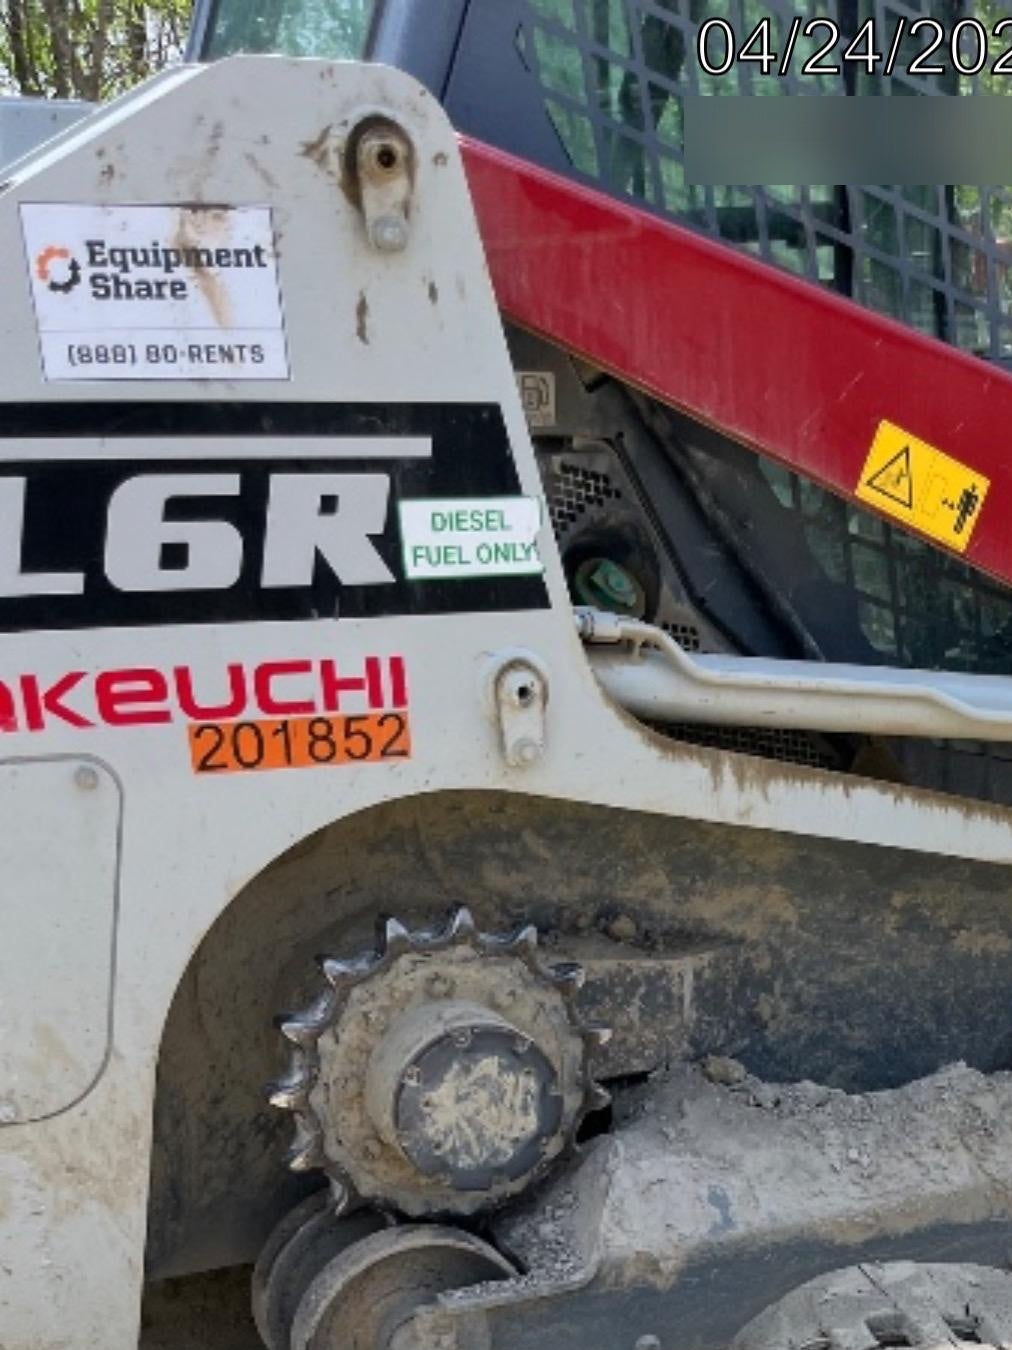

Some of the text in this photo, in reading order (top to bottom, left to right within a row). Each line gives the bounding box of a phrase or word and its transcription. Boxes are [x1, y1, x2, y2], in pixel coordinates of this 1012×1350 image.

[85, 240, 268, 273] Equipment
[89, 273, 187, 300] Share
[431, 510, 513, 532] DIESEL
[412, 542, 537, 567] FUEL ONLY
[194, 713, 409, 772] 201852
